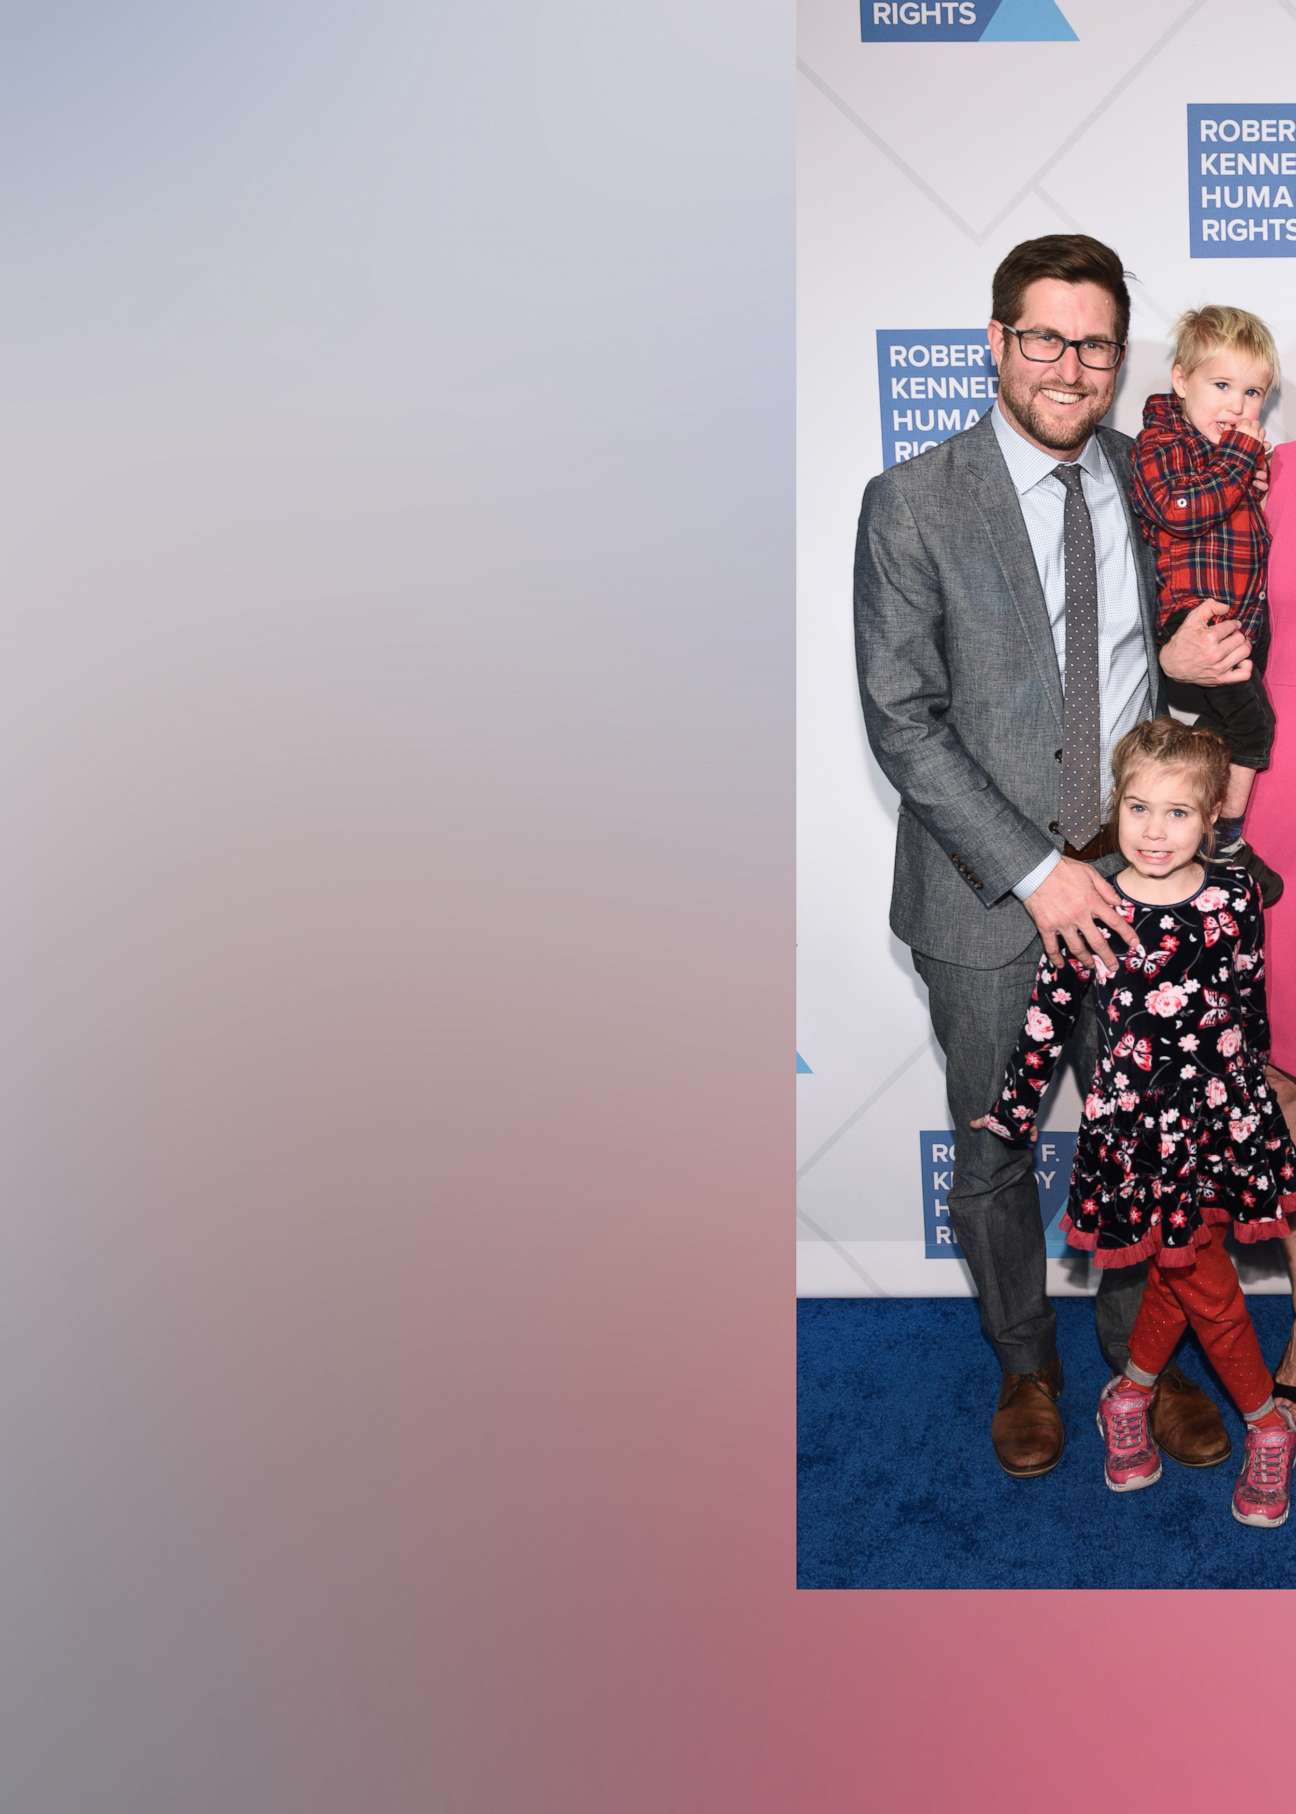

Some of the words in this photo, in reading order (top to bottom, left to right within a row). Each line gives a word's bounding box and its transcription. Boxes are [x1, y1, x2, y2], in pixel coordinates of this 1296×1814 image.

[873, 2, 976, 25] RIGHTS
[893, 408, 982, 431] HUMA
[1042, 1143, 1060, 1162] F.
